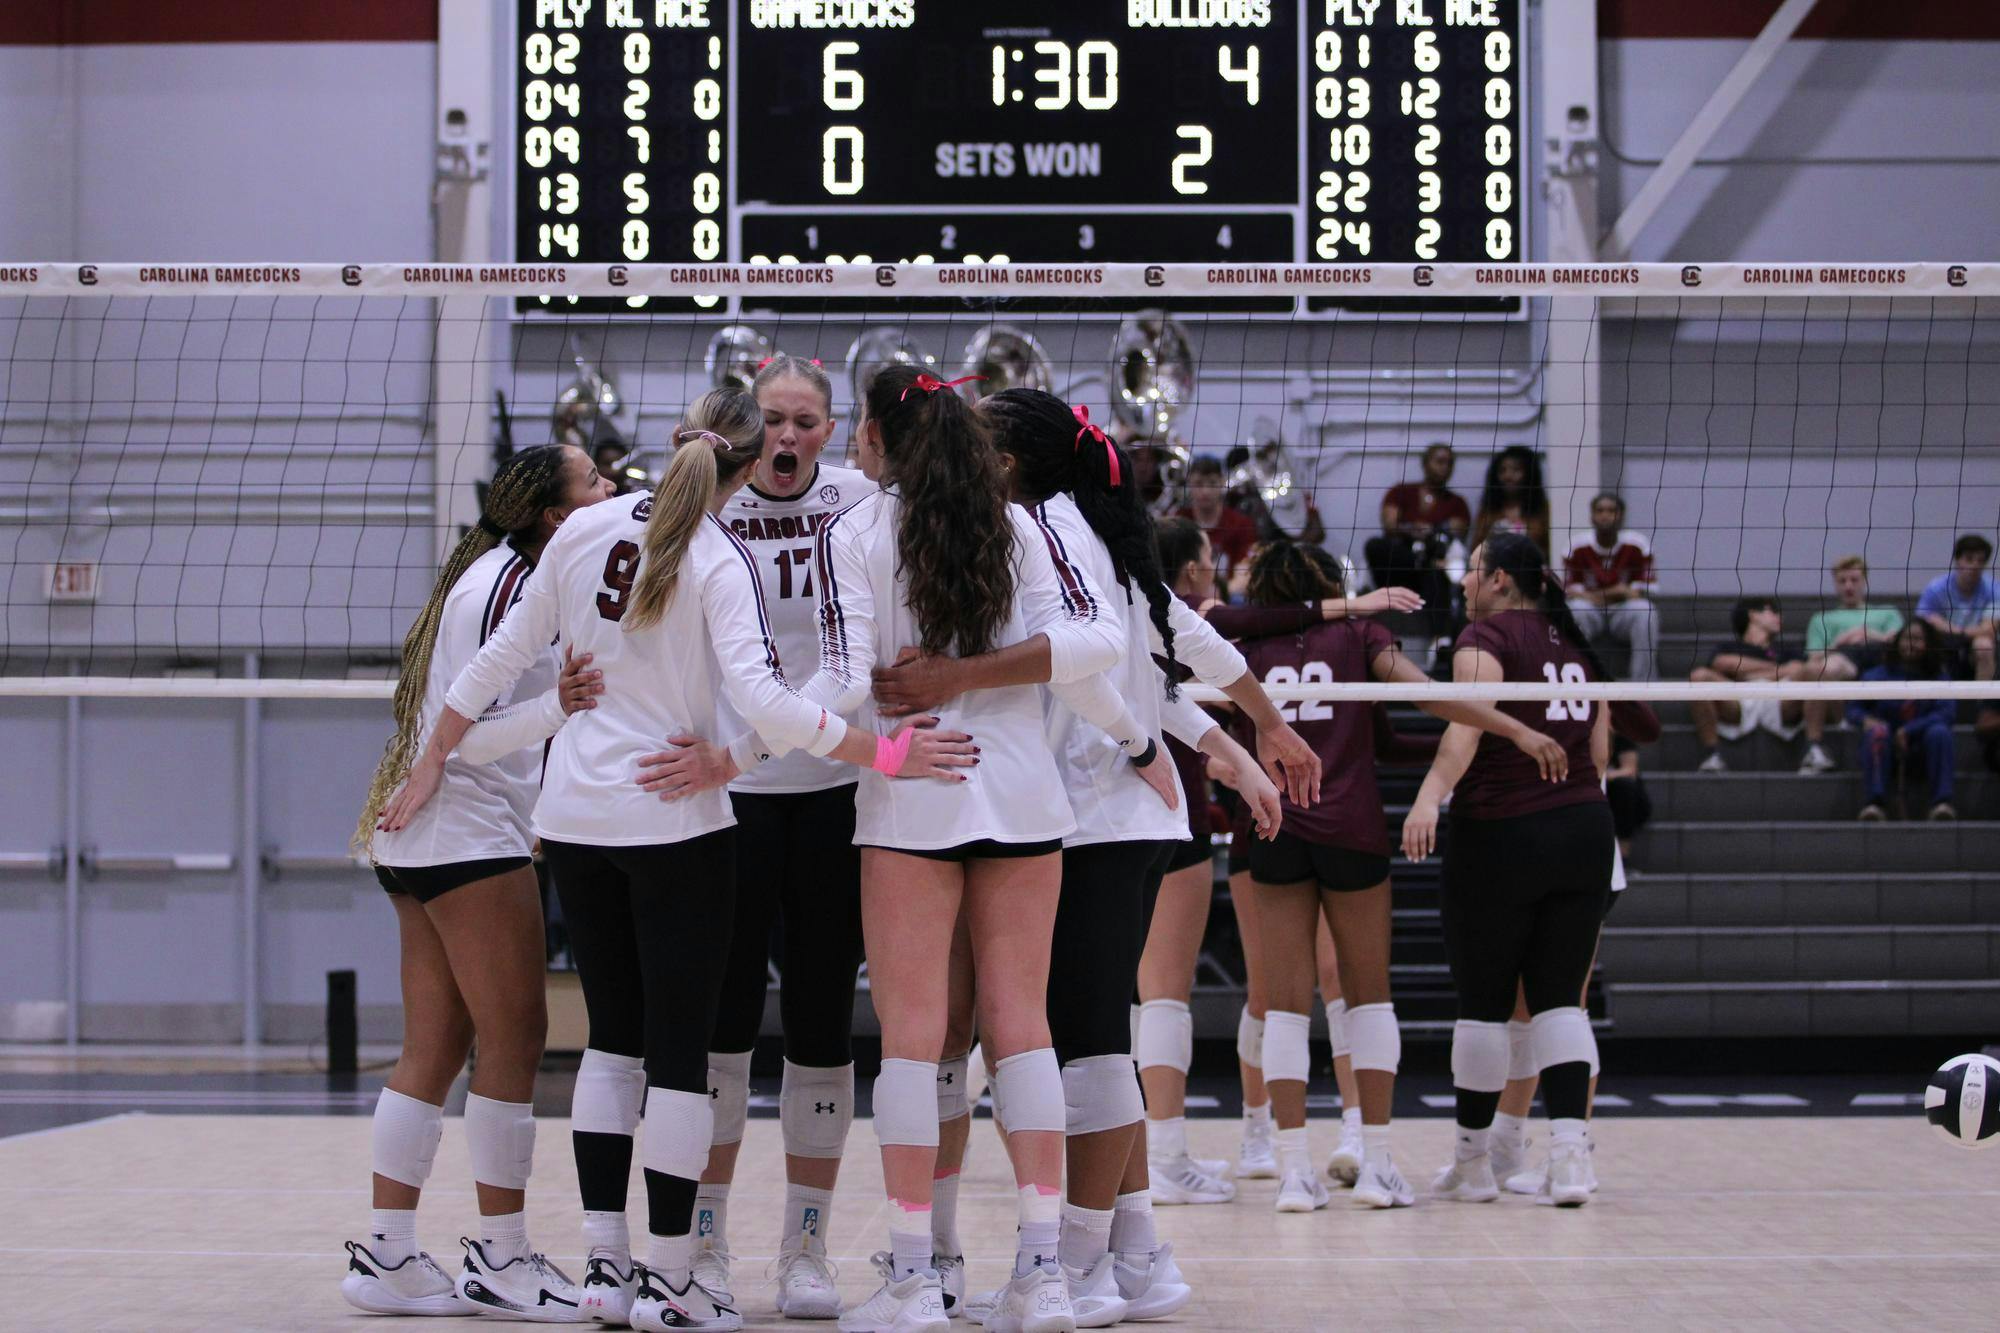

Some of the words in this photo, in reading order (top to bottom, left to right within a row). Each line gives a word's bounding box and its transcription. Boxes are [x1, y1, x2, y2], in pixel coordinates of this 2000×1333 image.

[537, 0, 591, 28] PLY
[655, 0, 711, 28] ACE
[750, 0, 915, 28] GAMECOCKS
[1128, 0, 1270, 28] BULLDOGS
[1325, 0, 1381, 26] PLY
[1445, 0, 1501, 26] ACE
[525, 33, 580, 74] 02
[624, 33, 650, 74] 0
[708, 36, 720, 70] 1
[1315, 31, 1370, 72] 01
[1414, 31, 1440, 72] 6
[1484, 31, 1511, 72] 0
[823, 41, 864, 111] 6
[992, 38, 1118, 110] 1:30
[1218, 45, 1260, 106] 4
[525, 79, 580, 121] 04
[624, 79, 650, 120] 2
[693, 79, 720, 120] 0
[1315, 78, 1371, 118] 03
[1401, 78, 1441, 118] 12
[1484, 78, 1511, 118] 0
[525, 126, 580, 167] 09
[626, 126, 650, 164] 7
[708, 129, 720, 163] 1
[823, 126, 864, 195] 0
[936, 143, 1015, 177] SETS
[1023, 142, 1100, 176] WON
[1171, 125, 1213, 194] 2
[1330, 125, 1371, 165] 10
[1414, 125, 1440, 165] 2
[1485, 125, 1511, 165] 0
[539, 173, 580, 214] 13
[623, 173, 650, 213] 5
[693, 173, 720, 214] 0
[1315, 172, 1371, 212] 22
[1418, 172, 1441, 212] 3
[1485, 172, 1512, 212] 0
[539, 223, 579, 258] 14
[623, 220, 650, 260] 0
[693, 220, 720, 260] 0
[806, 227, 818, 249] 1
[940, 226, 957, 249] 2
[1078, 225, 1095, 249] 3
[1216, 226, 1232, 248] 4
[1316, 218, 1371, 259] 24
[1414, 219, 1441, 259] 2
[1485, 219, 1512, 259] 0
[139, 267, 209, 284] CAROLINA
[214, 267, 301, 284] GAMECOCKS
[403, 267, 474, 284] CAROLINA
[479, 267, 567, 284] GAMECOCKS
[670, 267, 740, 284] CAROLINA
[746, 267, 834, 284] GAMECOCKS
[938, 267, 1009, 284] CAROLINA
[1015, 267, 1103, 284] GAMECOCKS
[1207, 267, 1278, 284] CAROLINA
[1283, 267, 1372, 284] GAMECOCKS
[1475, 267, 1546, 284] CAROLINA
[1552, 267, 1639, 284] GAMECOCKS
[1743, 267, 1814, 284] CAROLINA
[1819, 267, 1906, 284] GAMECOCKS
[596, 540, 641, 622] 9
[774, 548, 814, 599] 17
[1265, 661, 1333, 722] 22
